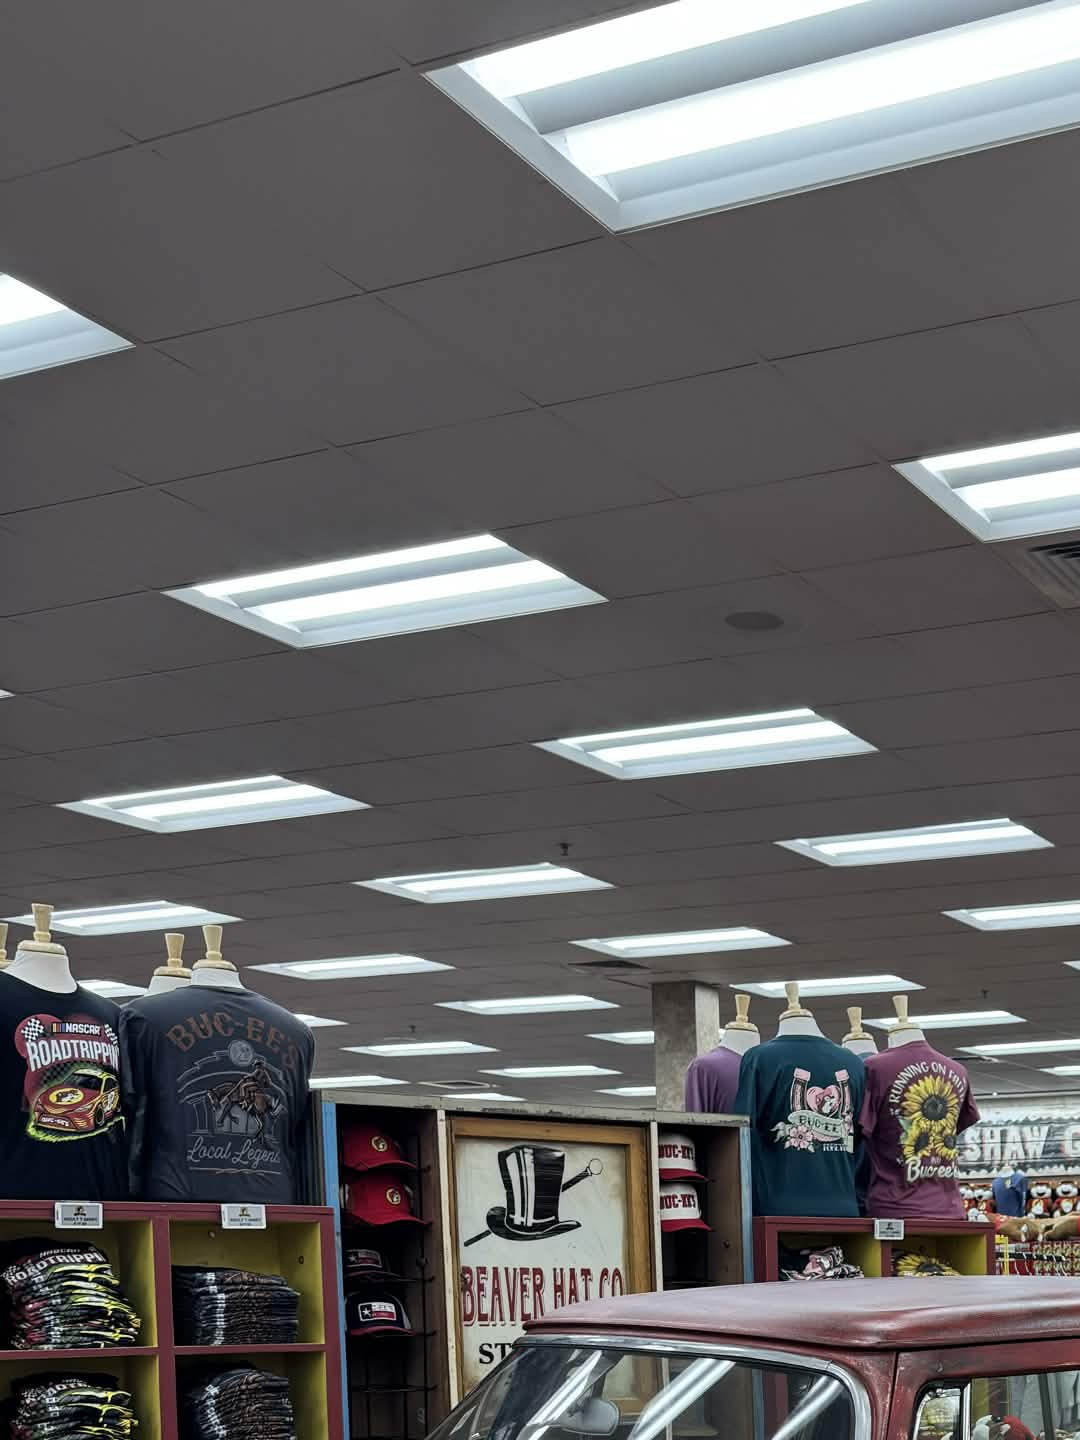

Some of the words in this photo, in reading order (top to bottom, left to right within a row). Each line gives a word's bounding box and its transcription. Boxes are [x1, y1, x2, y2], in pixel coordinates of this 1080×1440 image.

[65, 1022, 101, 1035] NASCAR
[889, 1061, 929, 1104] RUNNING
[931, 1062, 946, 1076] ON
[186, 1135, 232, 1163] Local
[460, 1265, 545, 1327] BEAVER
[552, 1267, 593, 1310] HAT
